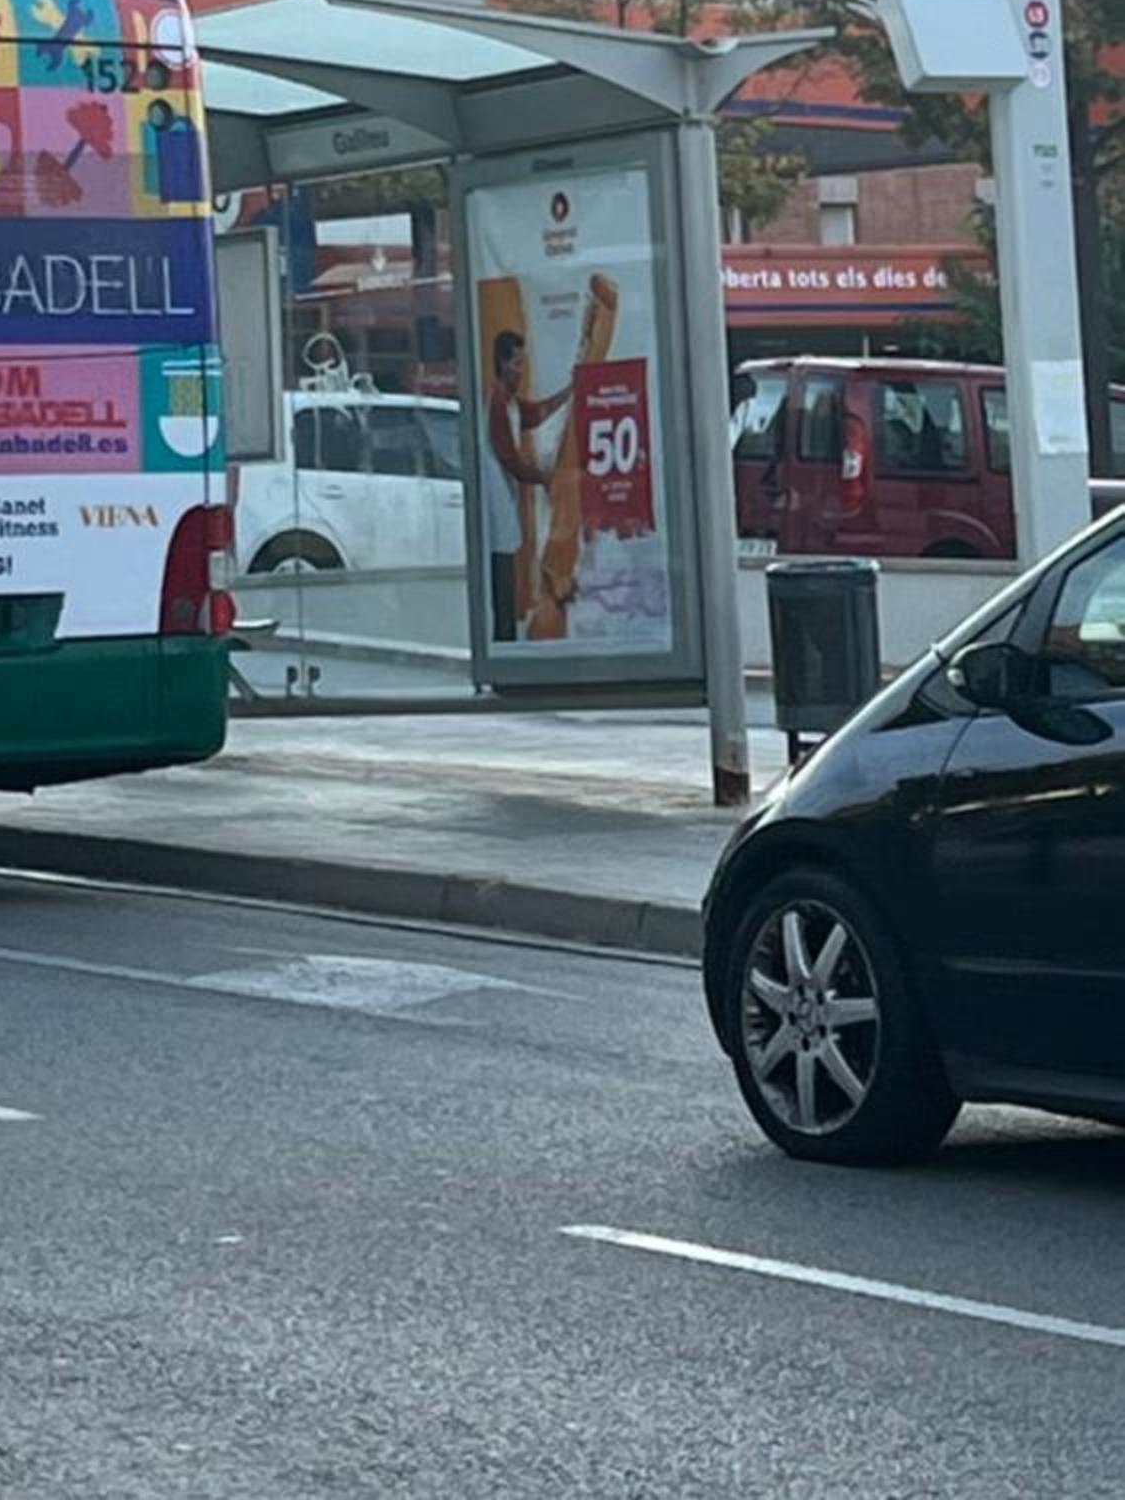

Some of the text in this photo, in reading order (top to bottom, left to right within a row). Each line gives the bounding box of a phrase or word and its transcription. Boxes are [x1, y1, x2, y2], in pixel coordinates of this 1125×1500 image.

[787, 267, 830, 289] tots
[836, 267, 867, 289] els
[873, 267, 917, 289] dies
[586, 416, 638, 476] 50
[79, 505, 160, 528] VIENA
